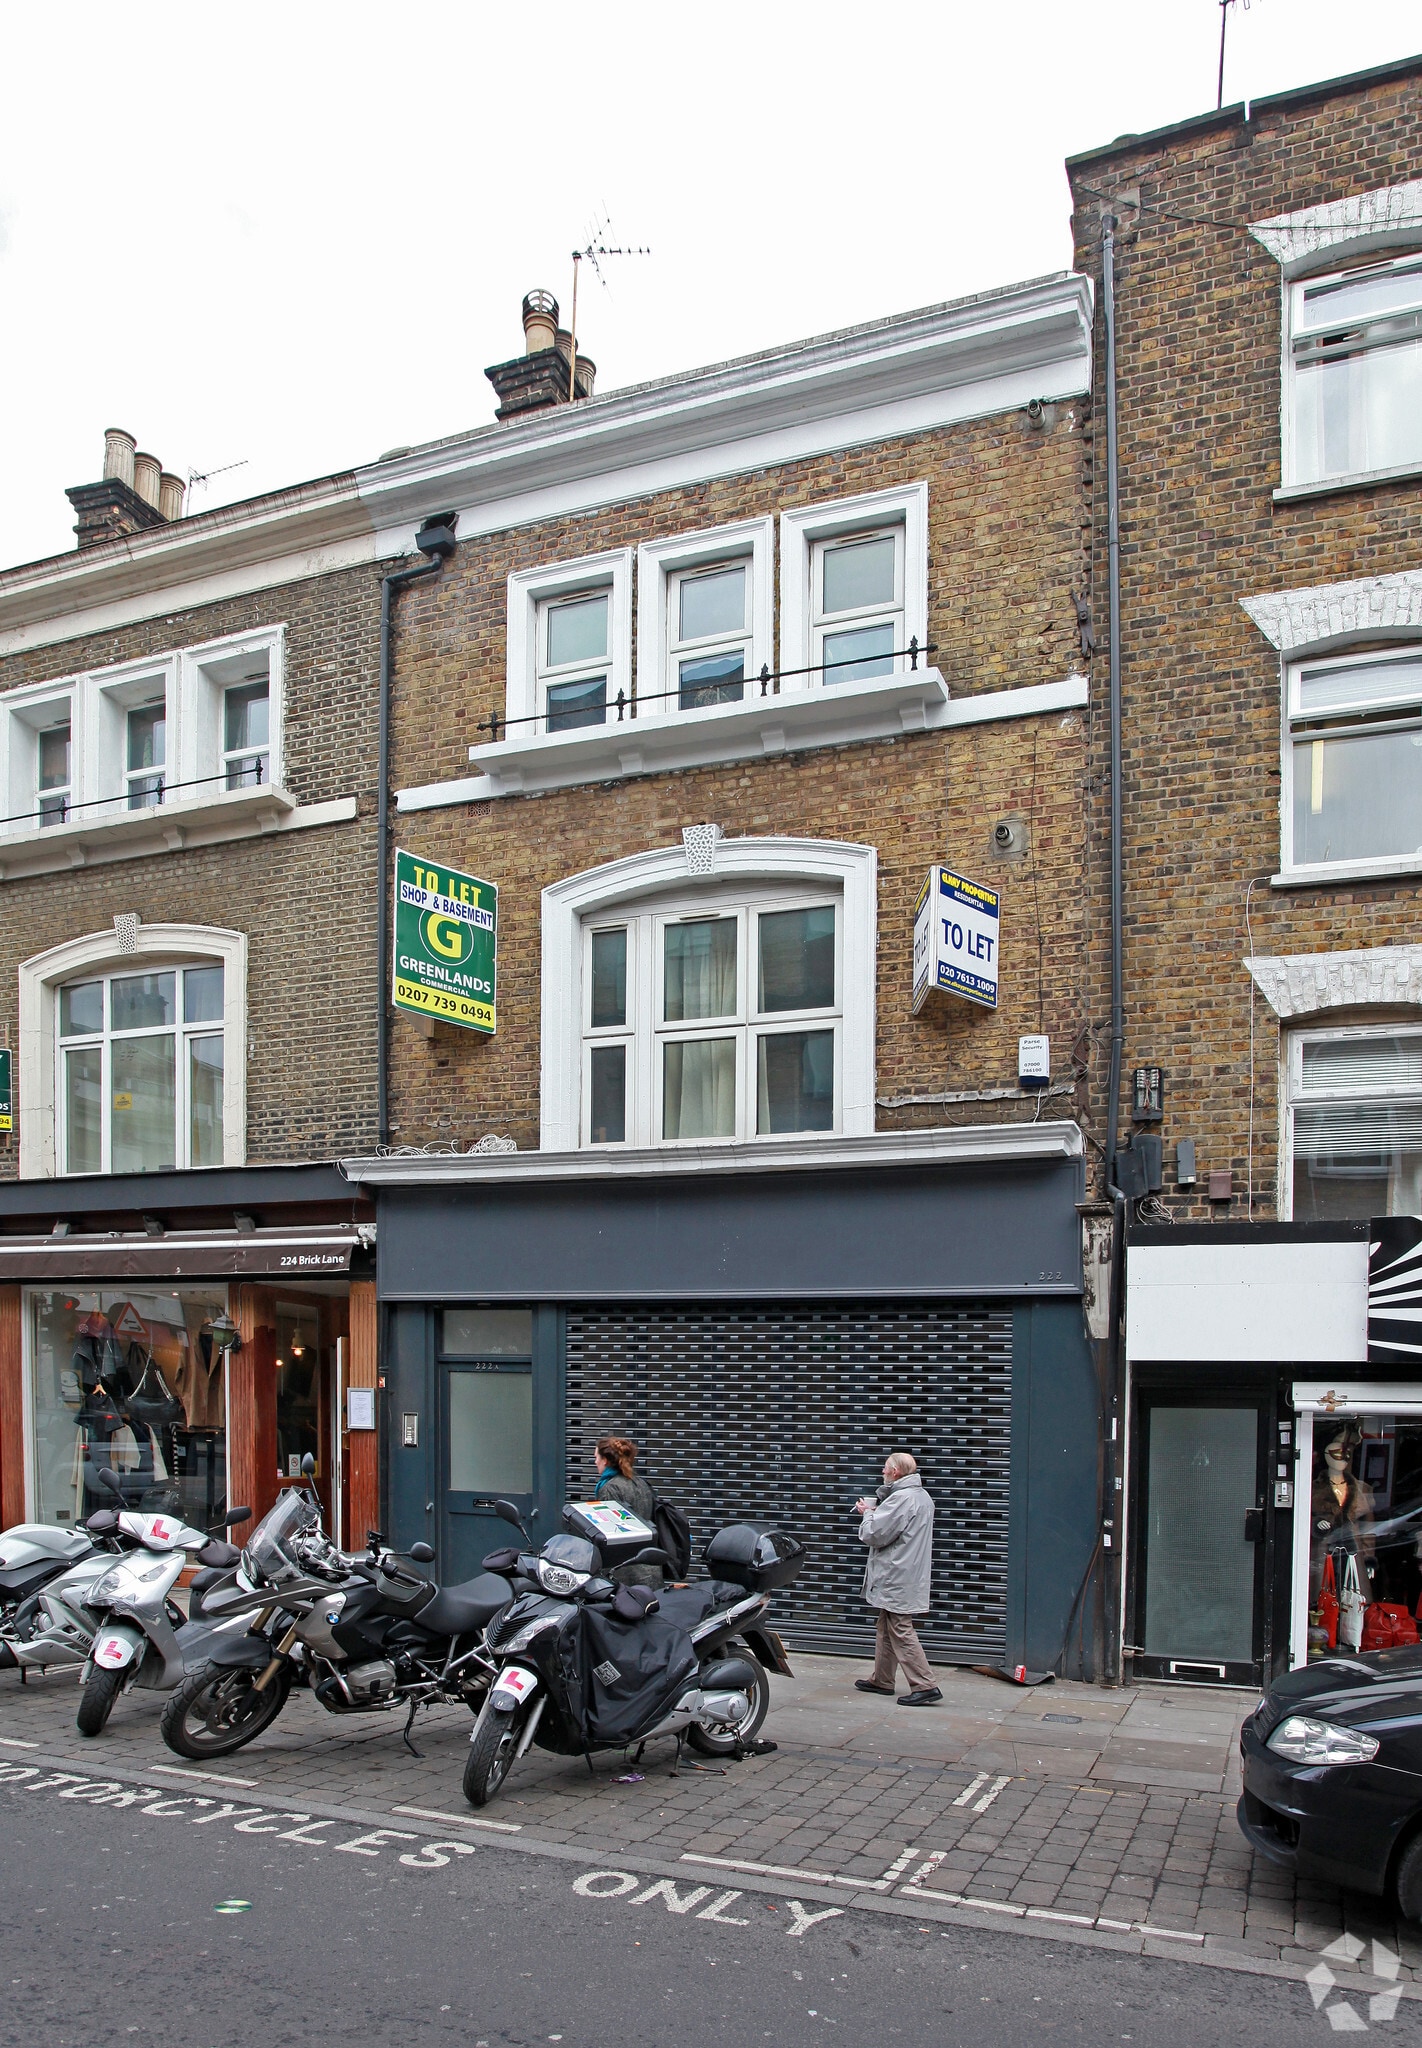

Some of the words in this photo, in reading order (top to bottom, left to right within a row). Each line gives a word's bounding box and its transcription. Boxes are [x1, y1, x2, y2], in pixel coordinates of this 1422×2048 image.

[413, 865, 439, 893] TO
[448, 878, 481, 908] LET
[954, 890, 985, 910] RESIDENTIAL
[961, 881, 997, 906] PROPERTIES
[401, 884, 428, 905] SHOP
[433, 895, 440, 910] &
[443, 899, 493, 927] BASEMENT
[426, 911, 462, 959] G
[941, 918, 964, 950] TO
[967, 929, 995, 963] LET
[399, 954, 491, 994] GREENLANDS
[420, 976, 471, 998] COMMERCIAL
[940, 964, 955, 978] 020
[956, 970, 975, 986] 7613
[976, 979, 995, 994] 1009
[398, 984, 429, 1004] 0207
[433, 995, 457, 1012] 739
[460, 1003, 492, 1022] 0494
[280, 1256, 298, 1266] 224
[298, 1254, 321, 1265] Brick
[321, 1254, 345, 1264] Lane
[1039, 1271, 1062, 1281] 222
[150, 1518, 170, 1541] L
[103, 1640, 123, 1660] L
[503, 1670, 525, 1691] L
[0, 1762, 477, 1868] OTORCYCLES
[571, 1870, 845, 1937] ONLY
